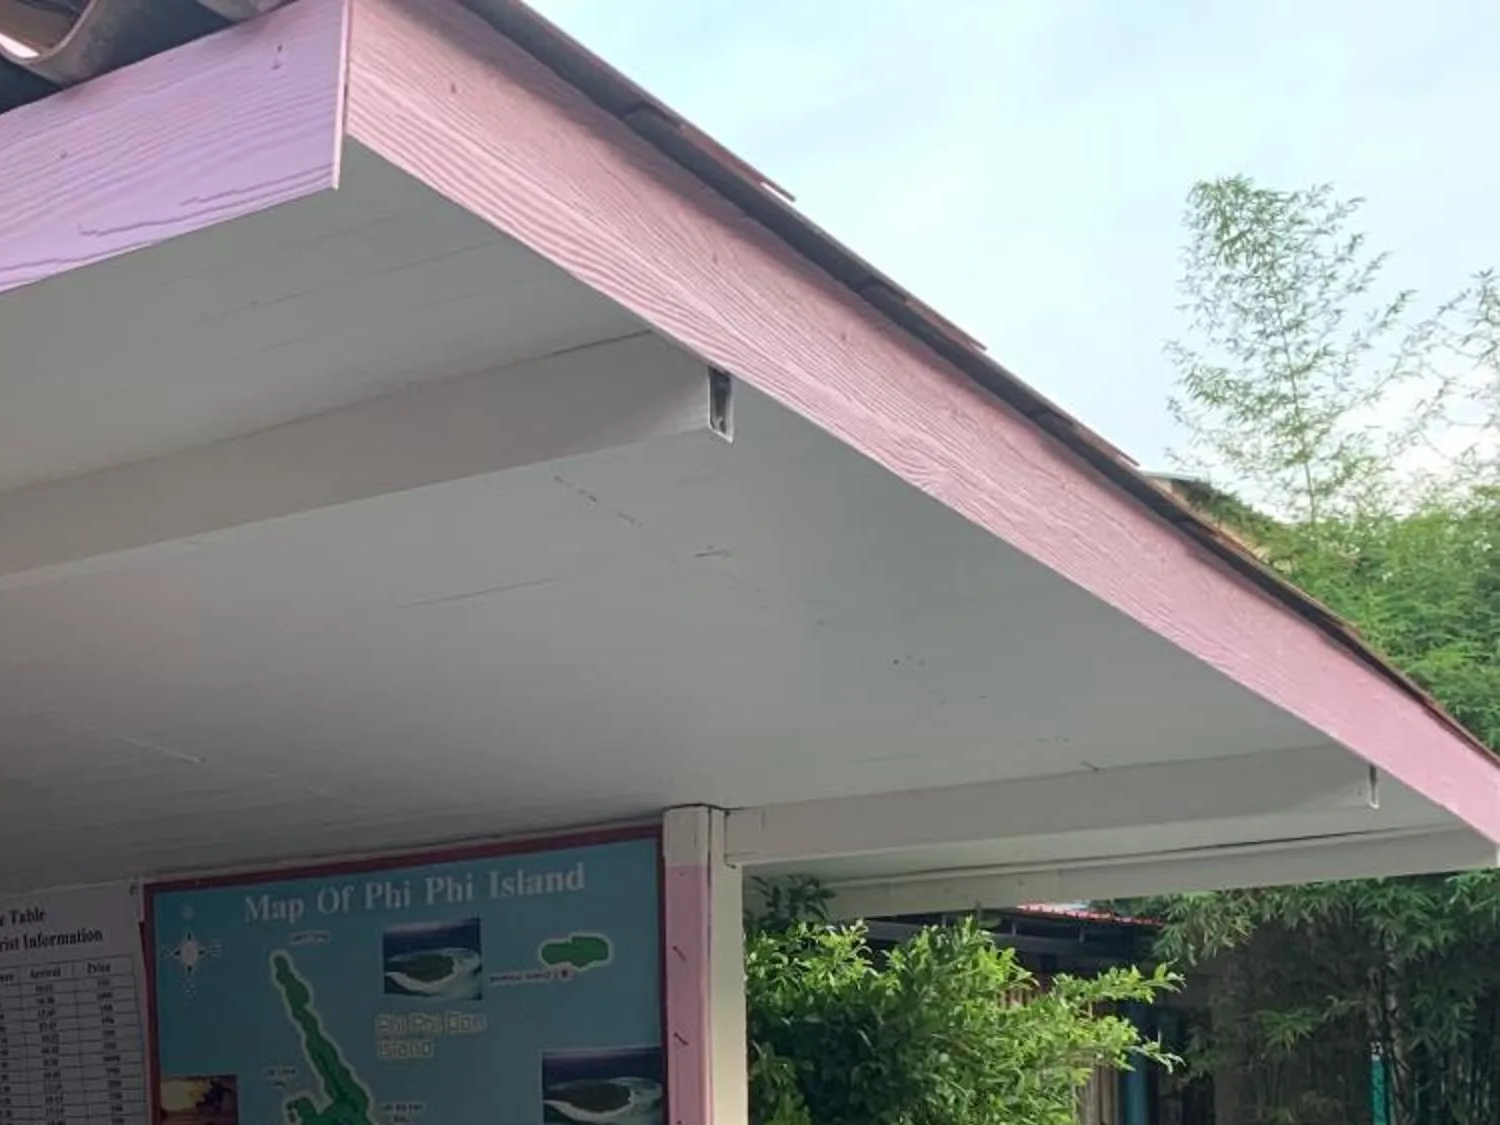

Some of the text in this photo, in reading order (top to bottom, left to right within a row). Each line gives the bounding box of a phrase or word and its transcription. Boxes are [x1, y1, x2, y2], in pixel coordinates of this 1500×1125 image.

[243, 863, 586, 923] Map Of Phi Phi Island
[10, 907, 47, 924] Table
[23, 928, 104, 950] Information
